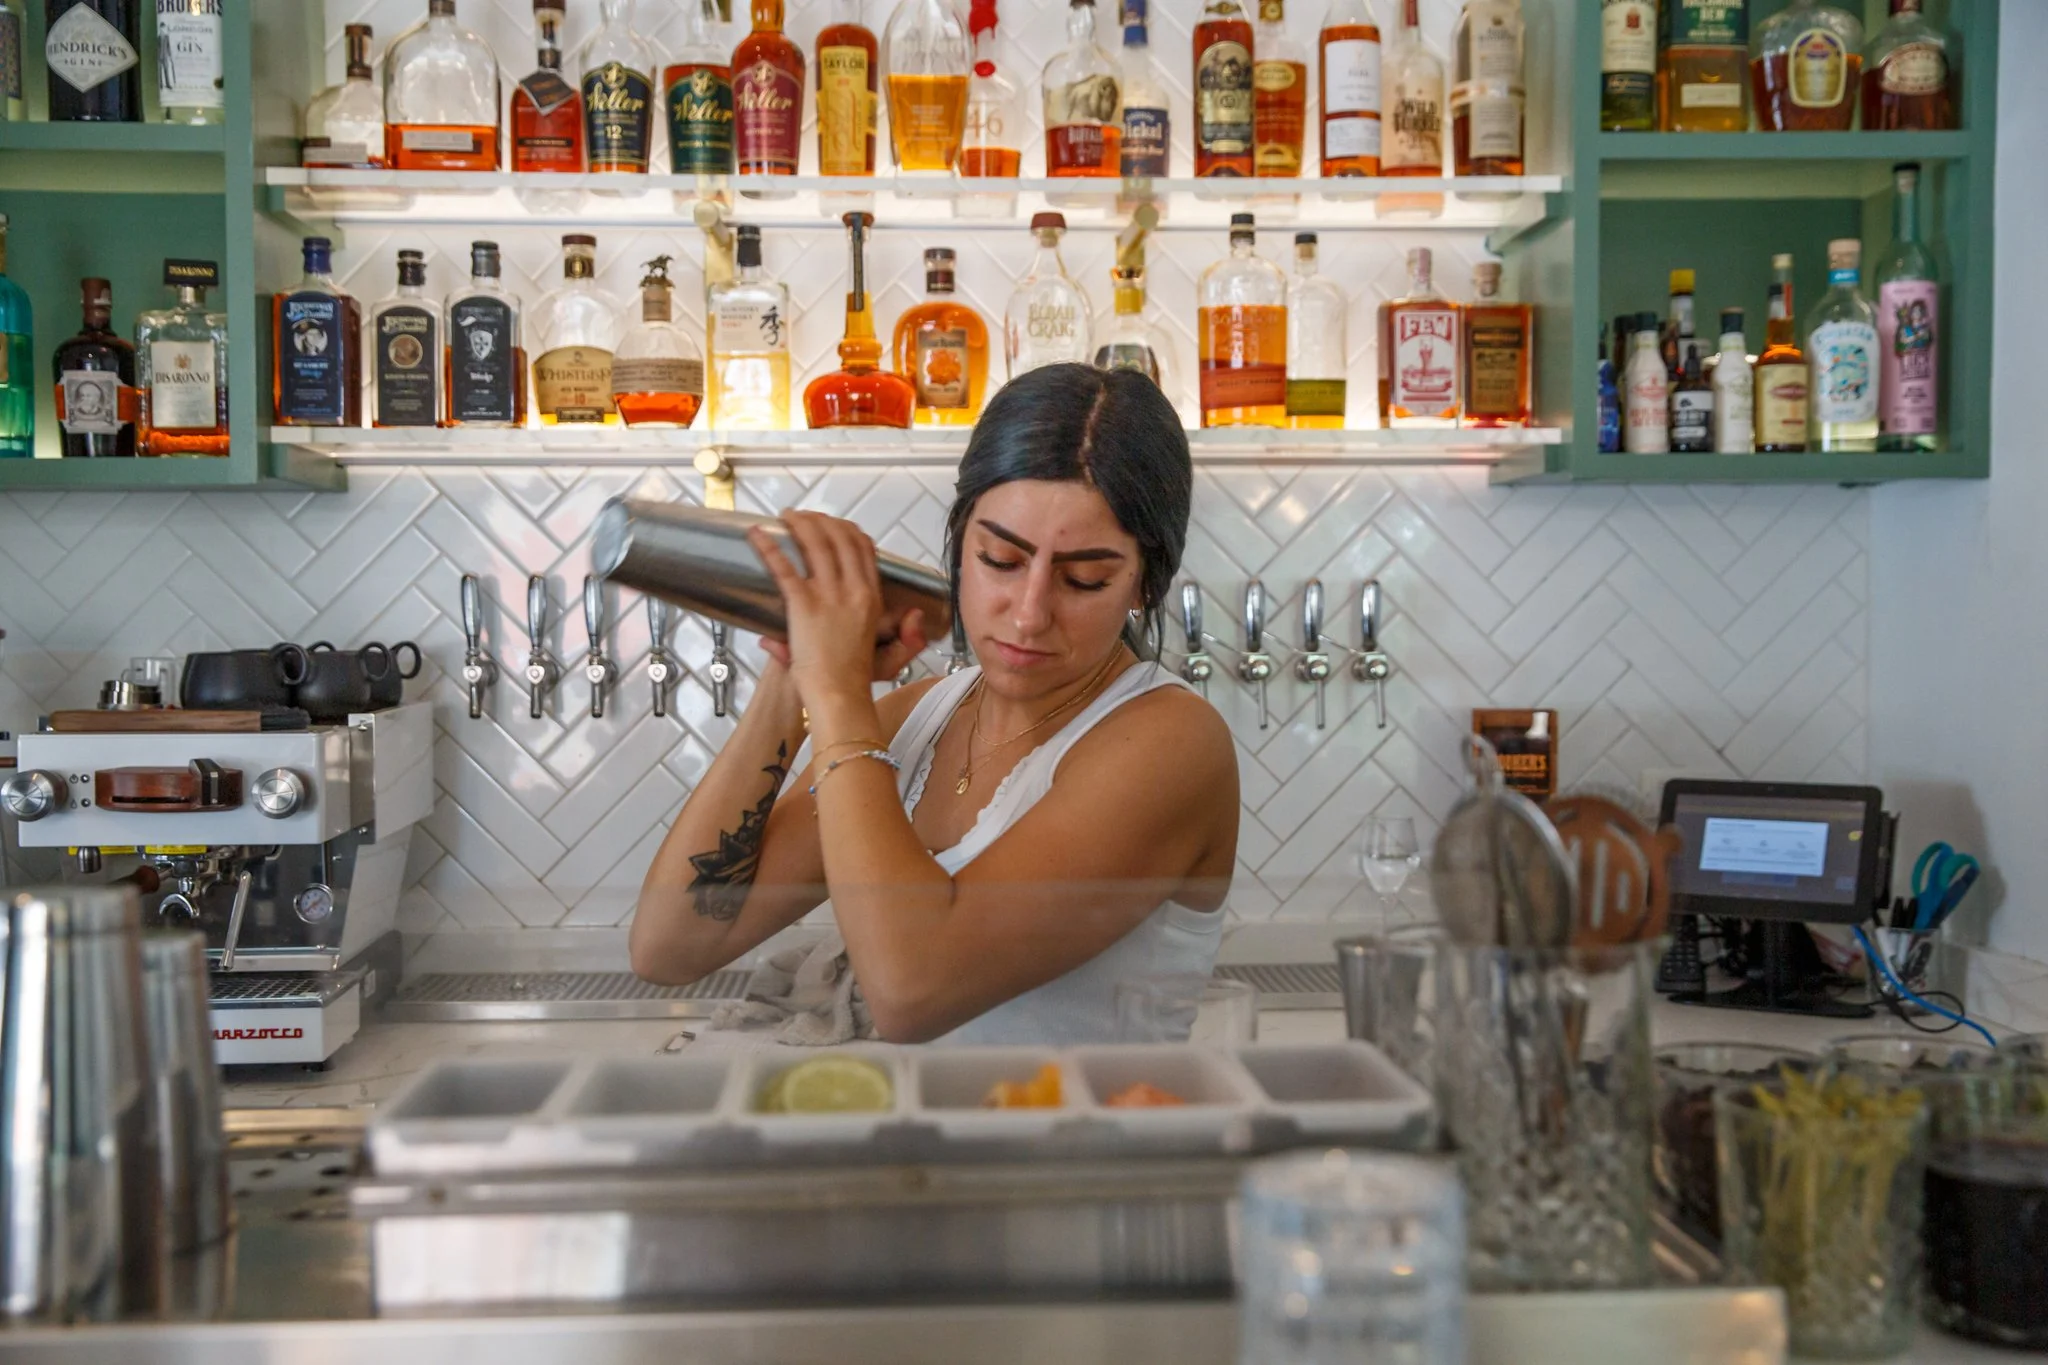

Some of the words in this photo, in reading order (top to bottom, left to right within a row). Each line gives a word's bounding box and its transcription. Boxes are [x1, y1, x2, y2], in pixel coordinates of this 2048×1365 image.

[47, 41, 128, 59] HENDRICK'S
[177, 41, 203, 53] GIN
[70, 57, 96, 66] GIN
[824, 58, 865, 69] TAYLOR
[586, 81, 644, 112] Weller
[739, 80, 792, 111] Weller
[674, 92, 733, 123] Weller
[966, 107, 1004, 137] 46
[606, 125, 622, 140] 12
[169, 266, 214, 278] DISARONNO
[1027, 320, 1075, 339] CRAIG
[1404, 316, 1452, 337] FEW
[155, 371, 211, 385] DISARONNO
